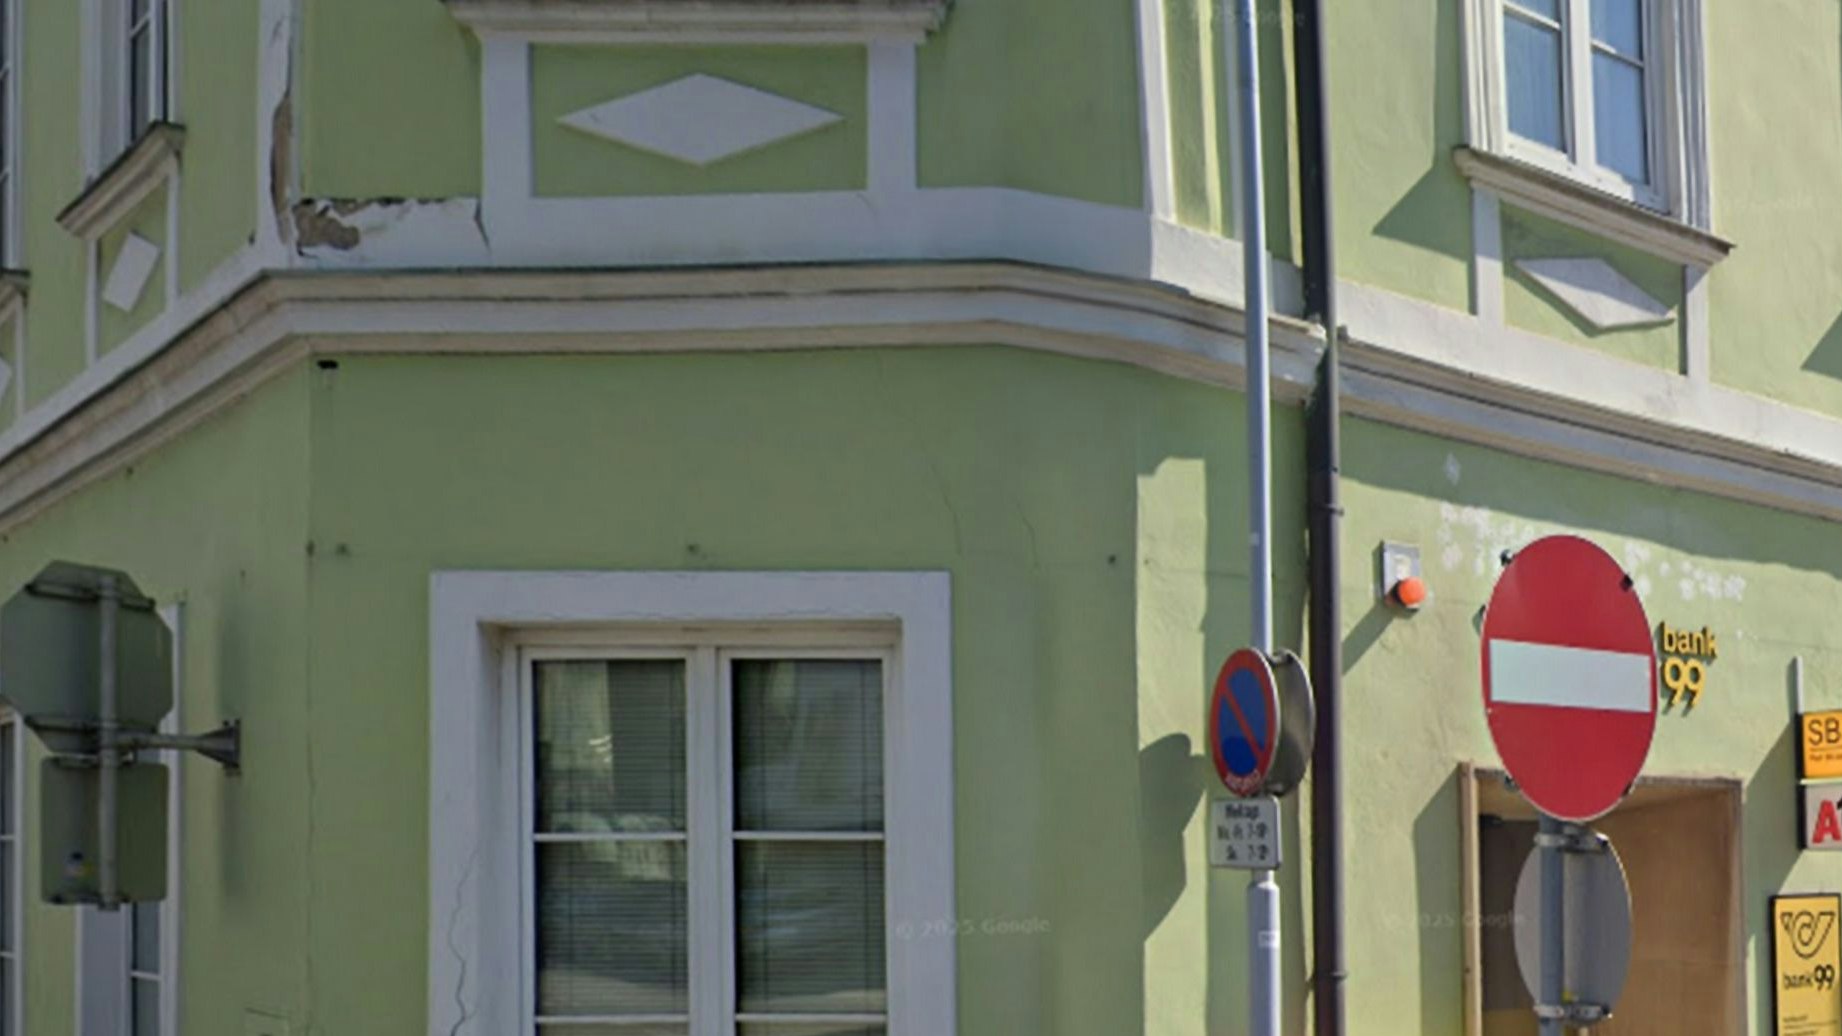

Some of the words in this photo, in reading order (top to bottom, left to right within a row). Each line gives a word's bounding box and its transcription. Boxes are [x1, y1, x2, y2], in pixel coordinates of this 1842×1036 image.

[1661, 622, 1718, 656] bank
[1662, 656, 1706, 707] 99
[1808, 717, 1842, 745] SB
